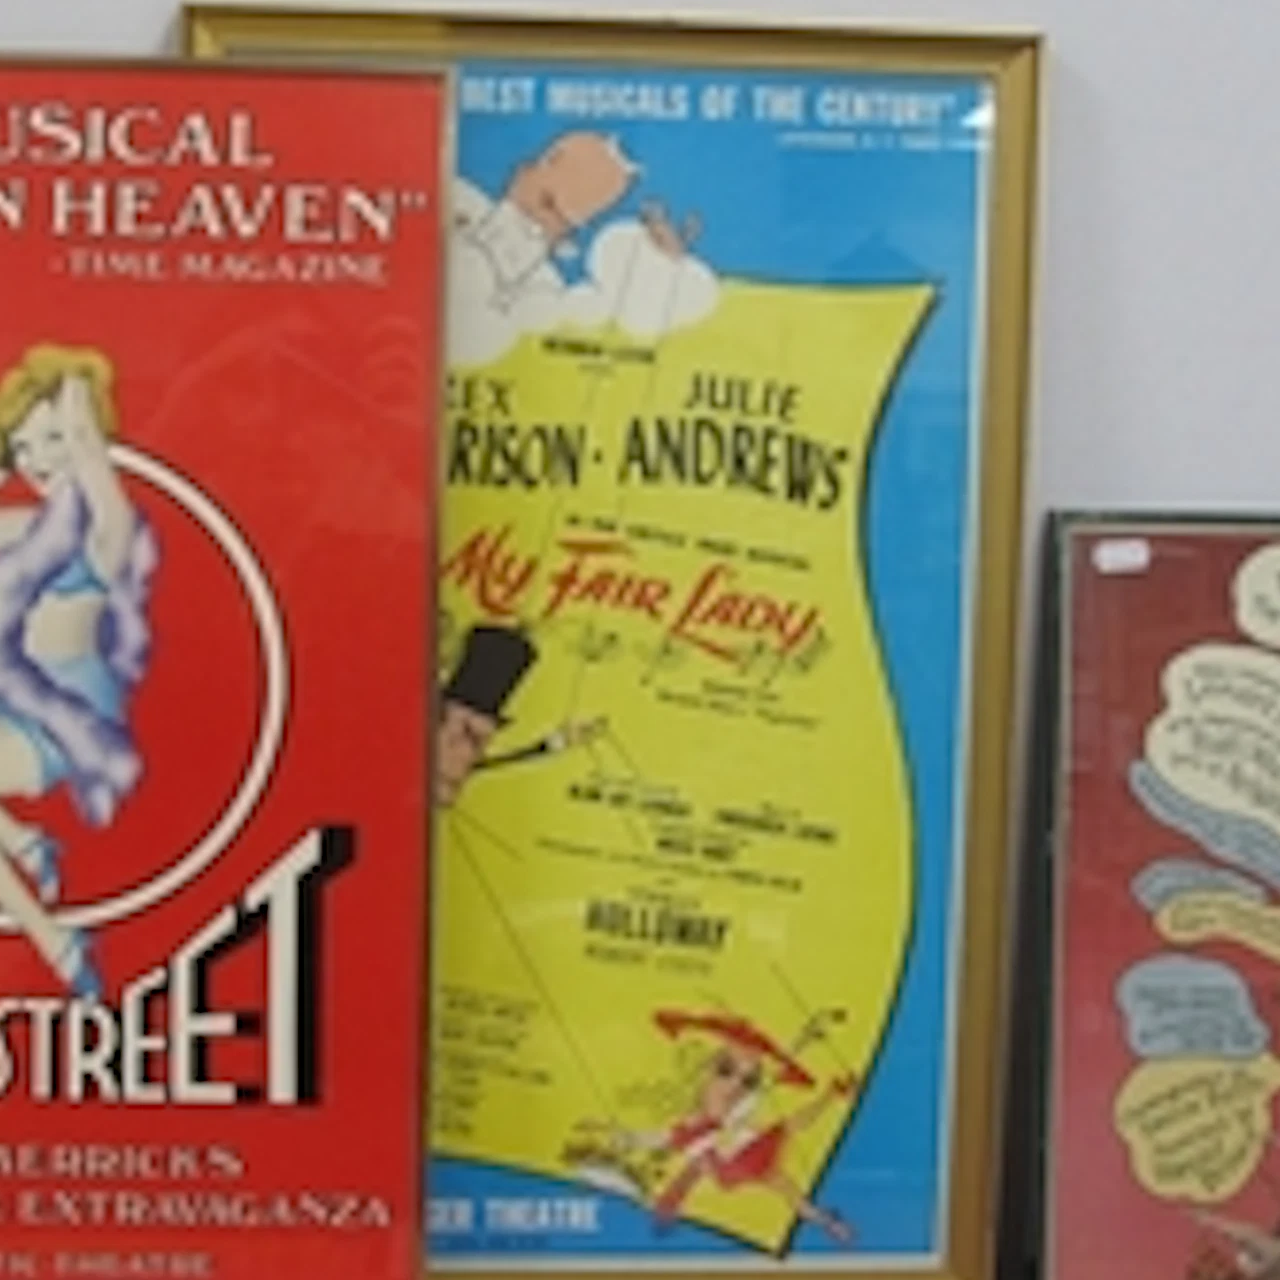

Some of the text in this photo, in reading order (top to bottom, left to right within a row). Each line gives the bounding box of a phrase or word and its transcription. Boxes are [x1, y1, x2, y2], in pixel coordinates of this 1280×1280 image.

[460, 75, 535, 113] BEST
[547, 80, 689, 120] MUSICALS
[700, 84, 740, 121] OF
[753, 86, 808, 124] THE
[178, 250, 389, 287] MAGAZINE
[683, 370, 804, 422] JULIE
[617, 417, 850, 512] ANDREWS
[19, 1189, 392, 1228] EXTRAVAGANZA
